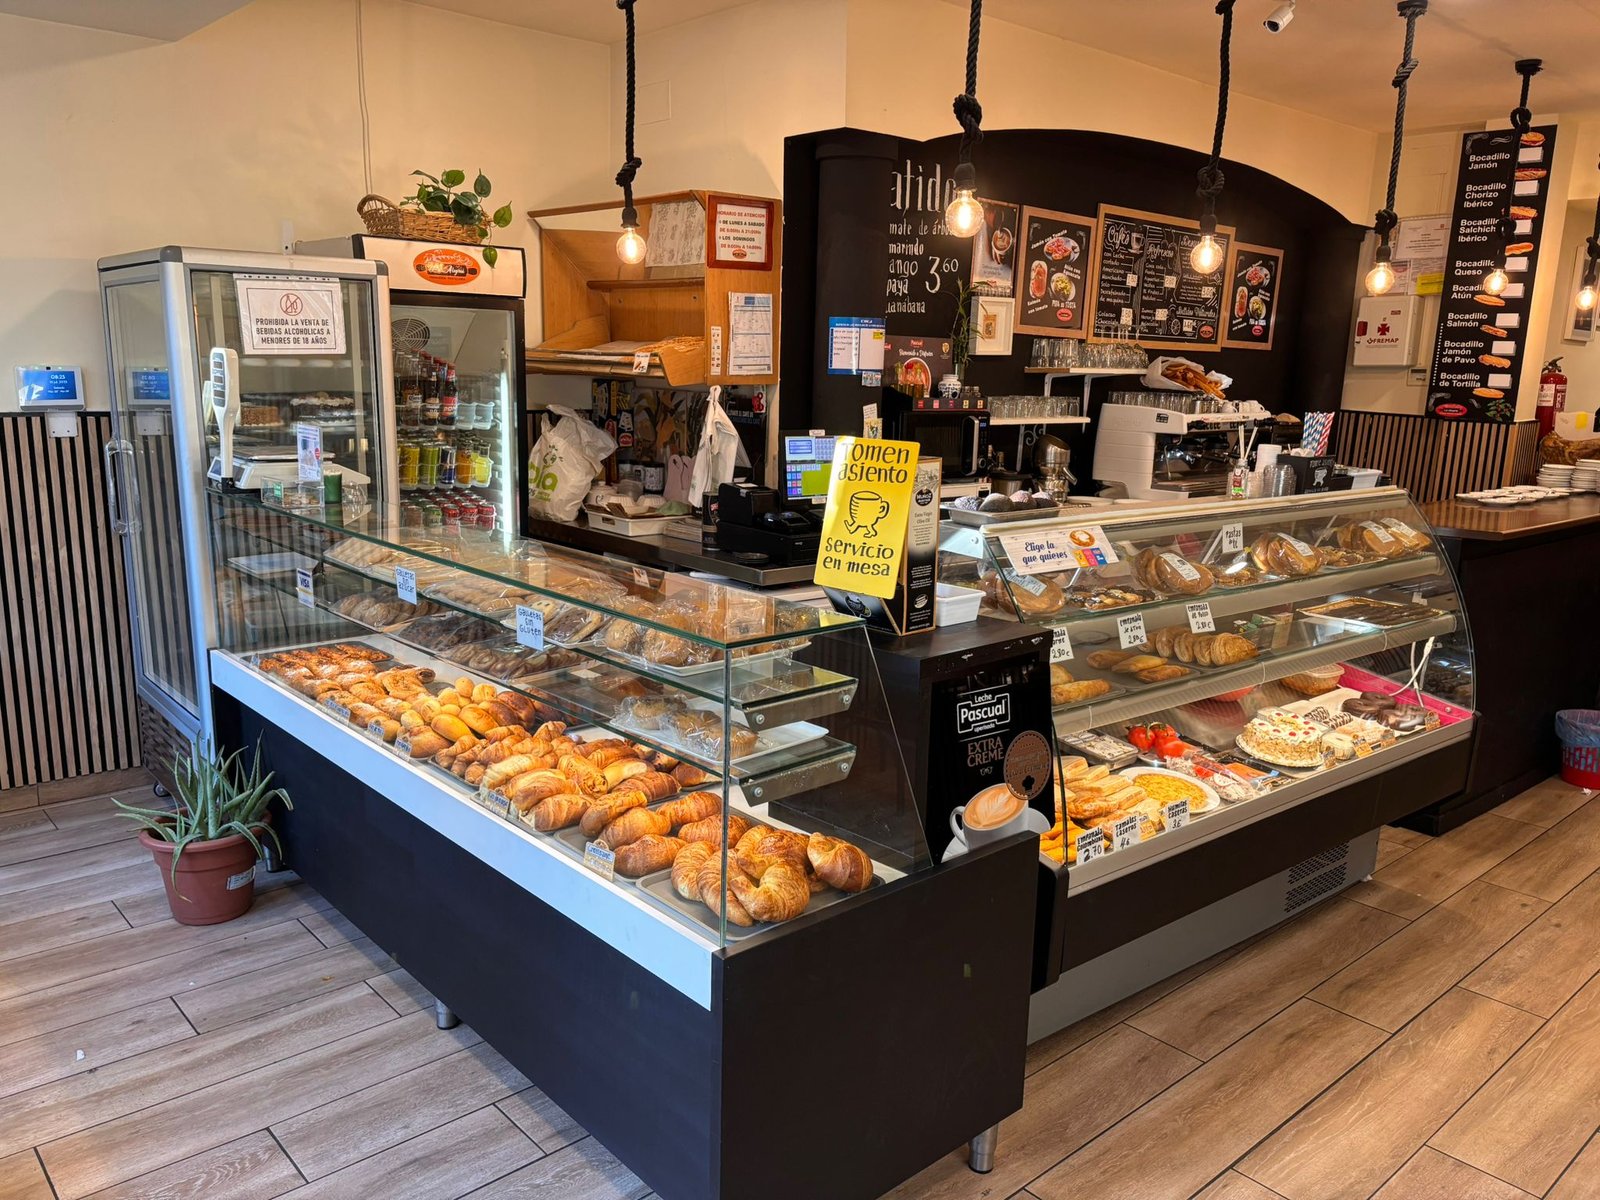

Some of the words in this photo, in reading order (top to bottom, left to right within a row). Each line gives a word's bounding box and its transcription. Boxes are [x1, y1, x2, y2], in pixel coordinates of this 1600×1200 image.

[1469, 152, 1510, 162] Bocadillo
[1468, 160, 1498, 170] Jamón
[1466, 182, 1506, 192] Bocadillo
[1465, 190, 1499, 200] Chorizo
[1463, 198, 1494, 209] Ibérico
[889, 218, 912, 236] mate
[932, 218, 953, 236] árbo
[1459, 224, 1497, 235] Salchich
[1457, 233, 1488, 243] Ibérico
[889, 238, 924, 256] marindo
[889, 258, 919, 278] ango
[1454, 267, 1483, 277] Queso
[886, 278, 909, 296] paya
[1451, 290, 1472, 300] Atún
[1447, 312, 1488, 321] Bocadillo
[256, 318, 289, 326] PROHIBIDA
[291, 318, 299, 326] LA
[1446, 319, 1479, 329] Salmón
[256, 327, 282, 335] BEBIDAS
[261, 337, 291, 345] MENORES
[292, 337, 301, 345] DE
[302, 337, 309, 345] 18
[311, 335, 328, 345] AÑOS
[1444, 340, 1484, 349] Bocadillo
[1443, 347, 1472, 357] Jamón
[1441, 356, 1454, 364] de
[1455, 356, 1476, 365] Pavo
[1440, 372, 1480, 381] Bocadillo
[1439, 380, 1450, 388] de
[1452, 380, 1481, 388] Tortilla
[842, 442, 910, 464] Tomen
[838, 461, 908, 484] asiento
[825, 537, 894, 559] servicio
[1025, 541, 1045, 552] Elige
[1046, 540, 1055, 549] la
[1022, 555, 1037, 565] que
[1040, 550, 1068, 563] quieres
[822, 556, 842, 570] en
[845, 561, 890, 577] mesa
[974, 693, 993, 703] Leche
[960, 698, 1005, 723] Pascual
[967, 736, 1004, 755] EXTRA
